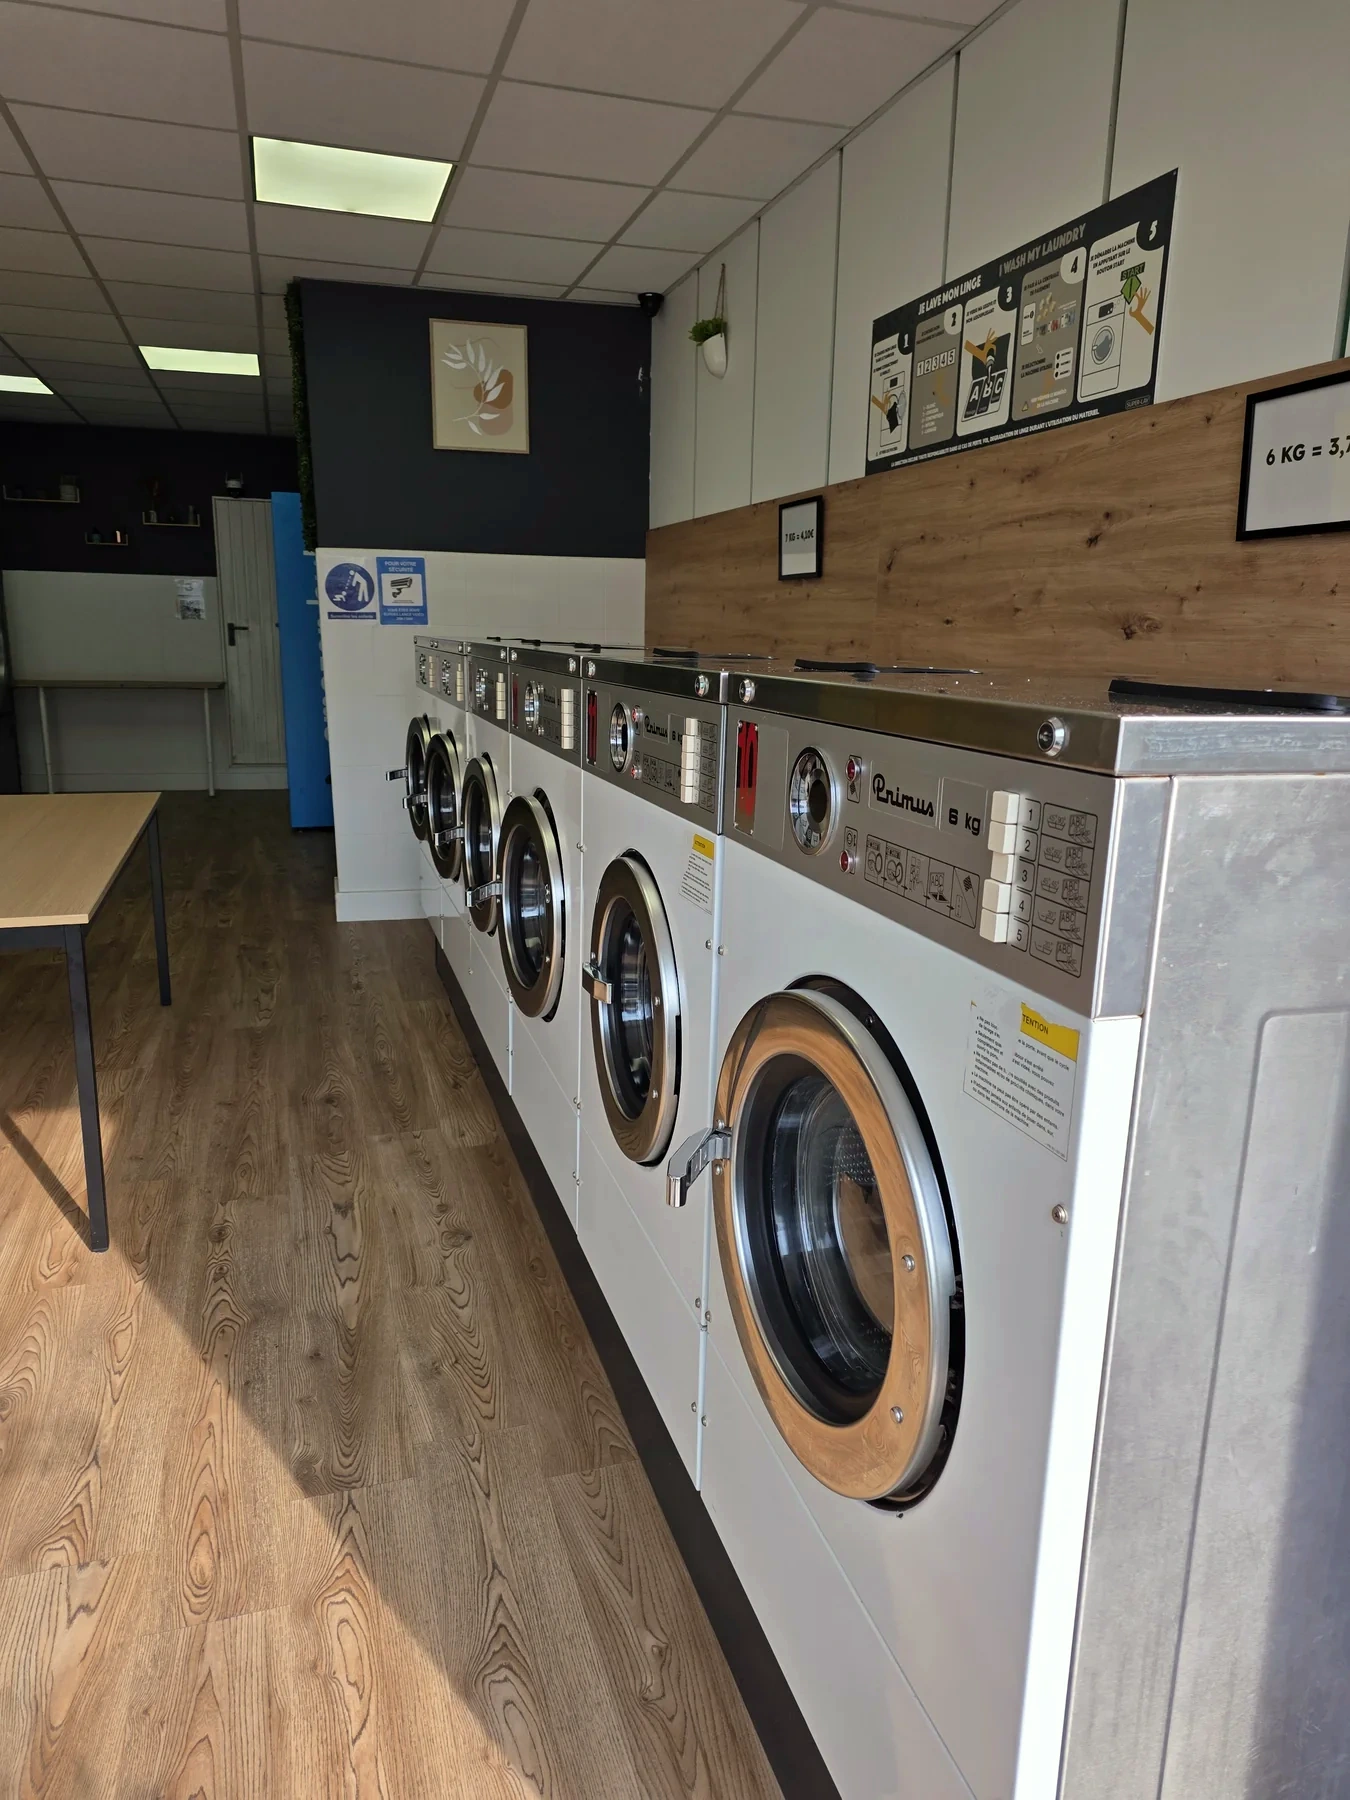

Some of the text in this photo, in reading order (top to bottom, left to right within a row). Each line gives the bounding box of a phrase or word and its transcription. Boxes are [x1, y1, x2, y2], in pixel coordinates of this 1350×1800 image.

[1149, 220, 1158, 241] 5
[1004, 252, 1026, 274] WASH
[1028, 245, 1042, 263] MY
[1042, 223, 1086, 257] LAUNDRY
[1118, 237, 1135, 249] MACHINE
[1071, 256, 1078, 274] 4
[1096, 259, 1125, 275] BOUTON START
[1098, 254, 1117, 267] APPUYANT
[1122, 265, 1144, 280] START
[918, 275, 982, 315] JE LAVE MON LINGE
[1006, 287, 1012, 303] 3
[951, 312, 957, 327] 2
[904, 334, 909, 348] 1
[933, 357, 938, 370] 3
[941, 353, 947, 367] 4
[949, 350, 955, 364] 5
[926, 360, 930, 373] 2
[970, 378, 1003, 402] A B C
[1030, 422, 1045, 432] DURANT
[1045, 415, 1071, 429] L'UTILISATION
[1266, 449, 1276, 466] 6
[1281, 444, 1306, 464] KG
[785, 534, 788, 542] 7
[789, 533, 796, 542] KG
[645, 715, 668, 738] Primus
[873, 773, 981, 836] Primus 6 kg
[1029, 809, 1033, 821] 1
[1025, 840, 1031, 852] 2
[1022, 870, 1028, 882] 3
[1019, 900, 1025, 912] 4
[1016, 929, 1022, 942] 5
[984, 1025, 994, 1035] lavage
[1022, 1014, 1048, 1035] TENTION
[978, 1030, 995, 1044] Seulement
[1059, 1062, 1069, 1071] cycle
[979, 1075, 992, 1086] machine
[1032, 1070, 1040, 1078] vous
[1041, 1076, 1054, 1087] pouvez
[1028, 1084, 1036, 1092] avec
[1044, 1094, 1060, 1107] produits
[1045, 1102, 1054, 1110] dans
[1055, 1108, 1065, 1118] votre
[1027, 1115, 1036, 1124] jouer
